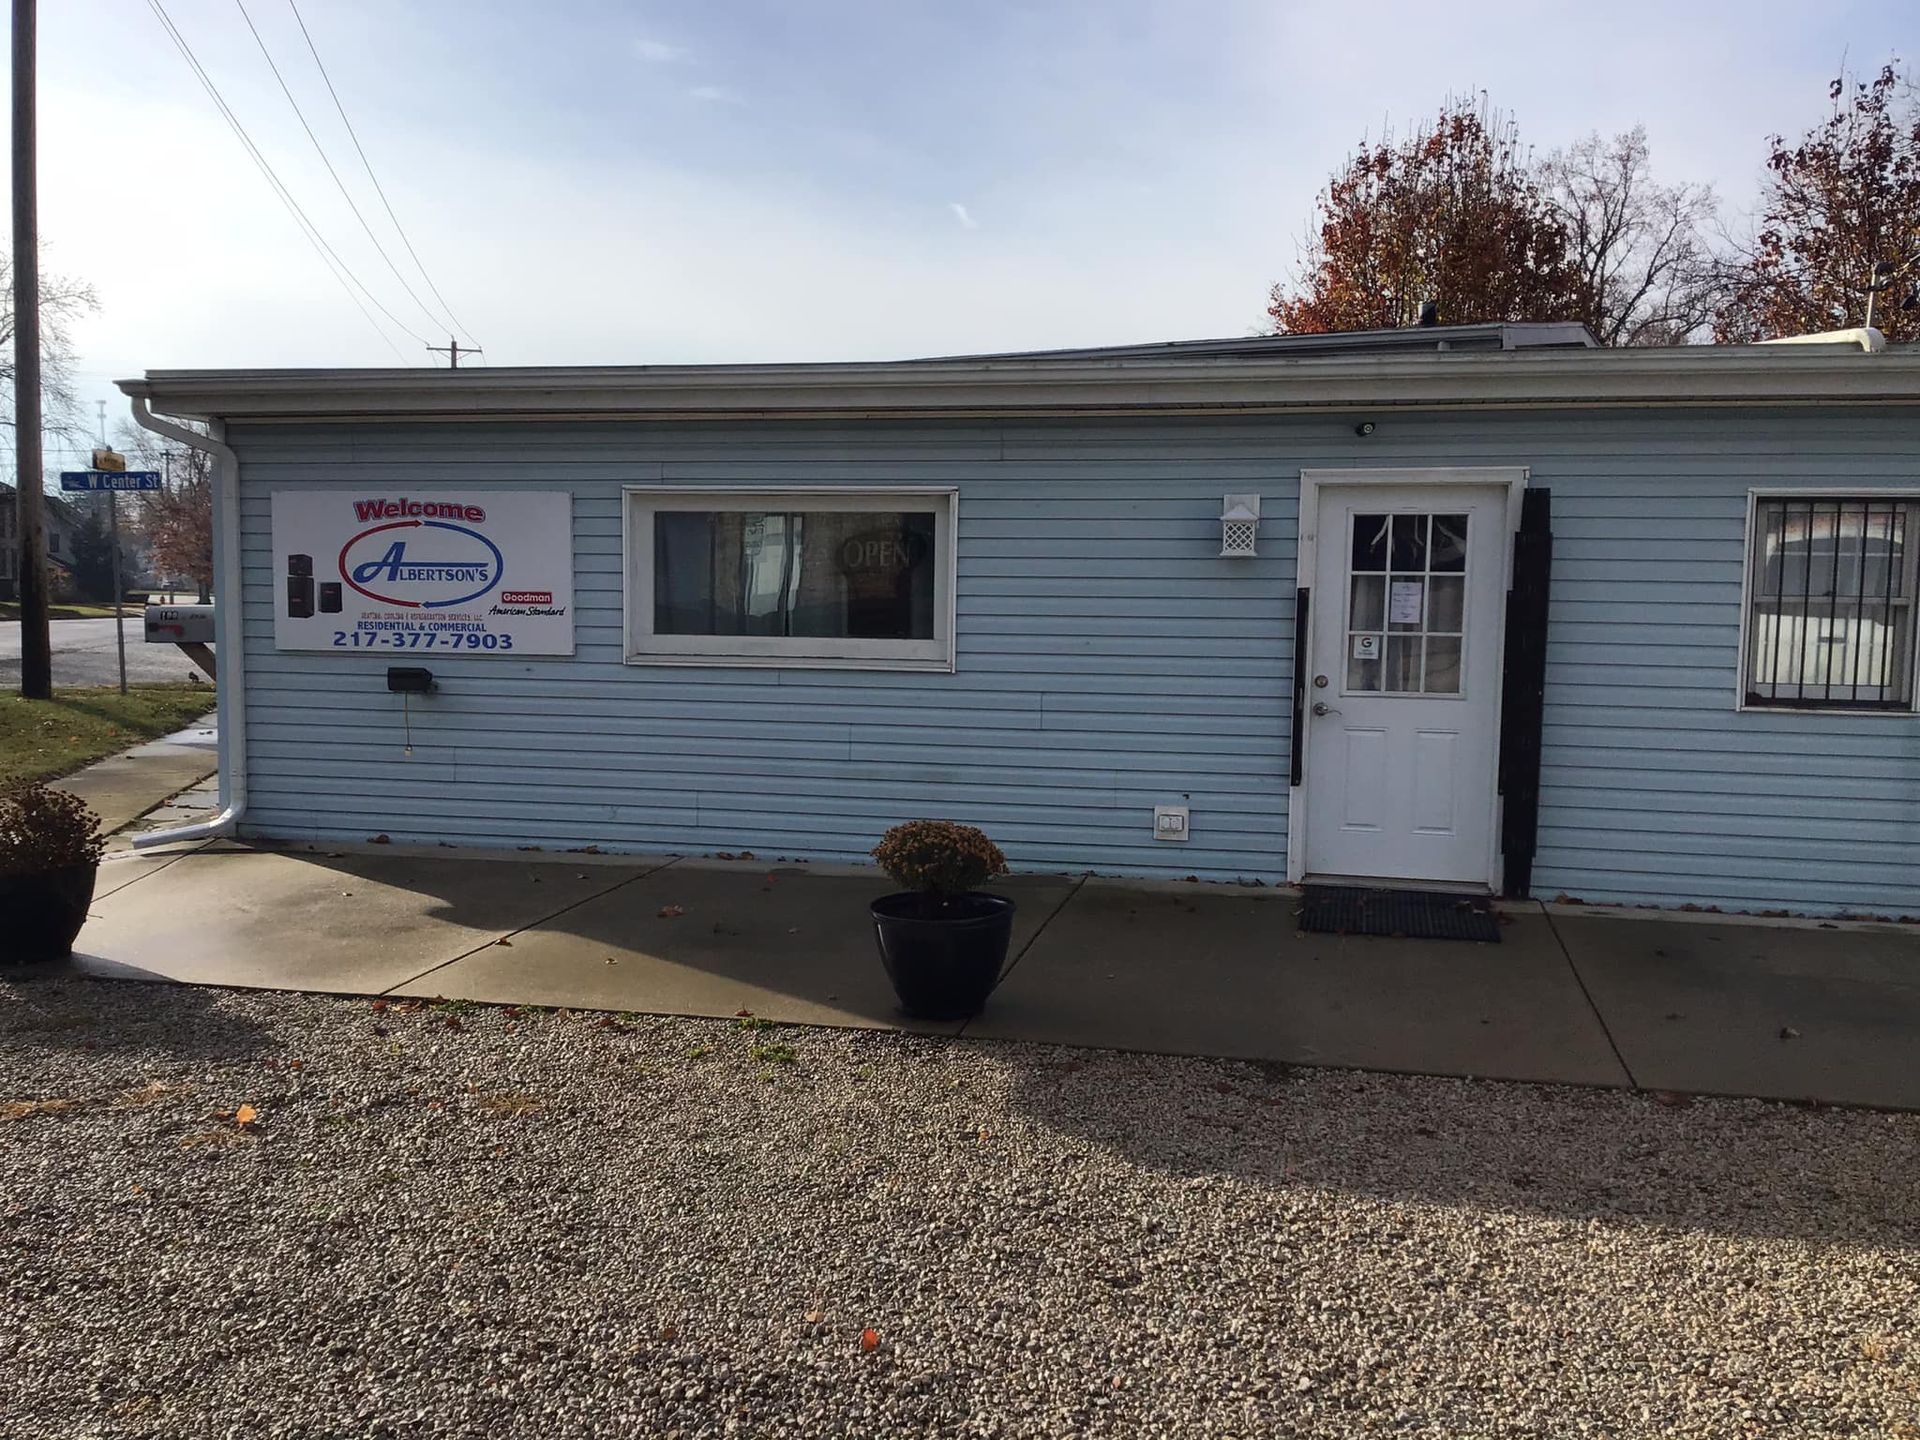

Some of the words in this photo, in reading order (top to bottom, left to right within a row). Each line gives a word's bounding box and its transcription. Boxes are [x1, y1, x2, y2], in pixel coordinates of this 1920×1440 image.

[87, 474, 98, 488] W
[103, 474, 141, 488] Center
[145, 474, 158, 488] St
[354, 497, 486, 523] Welcome
[843, 539, 911, 568] OPEN
[503, 592, 551, 602] Goodman
[488, 606, 526, 616] American
[526, 606, 566, 617] Standard
[357, 621, 416, 631] RESIDENTIAL
[418, 622, 426, 631] &
[428, 622, 487, 632] COMMERCIAL
[333, 631, 513, 649] 217-377-7903
[1361, 637, 1373, 648] G
